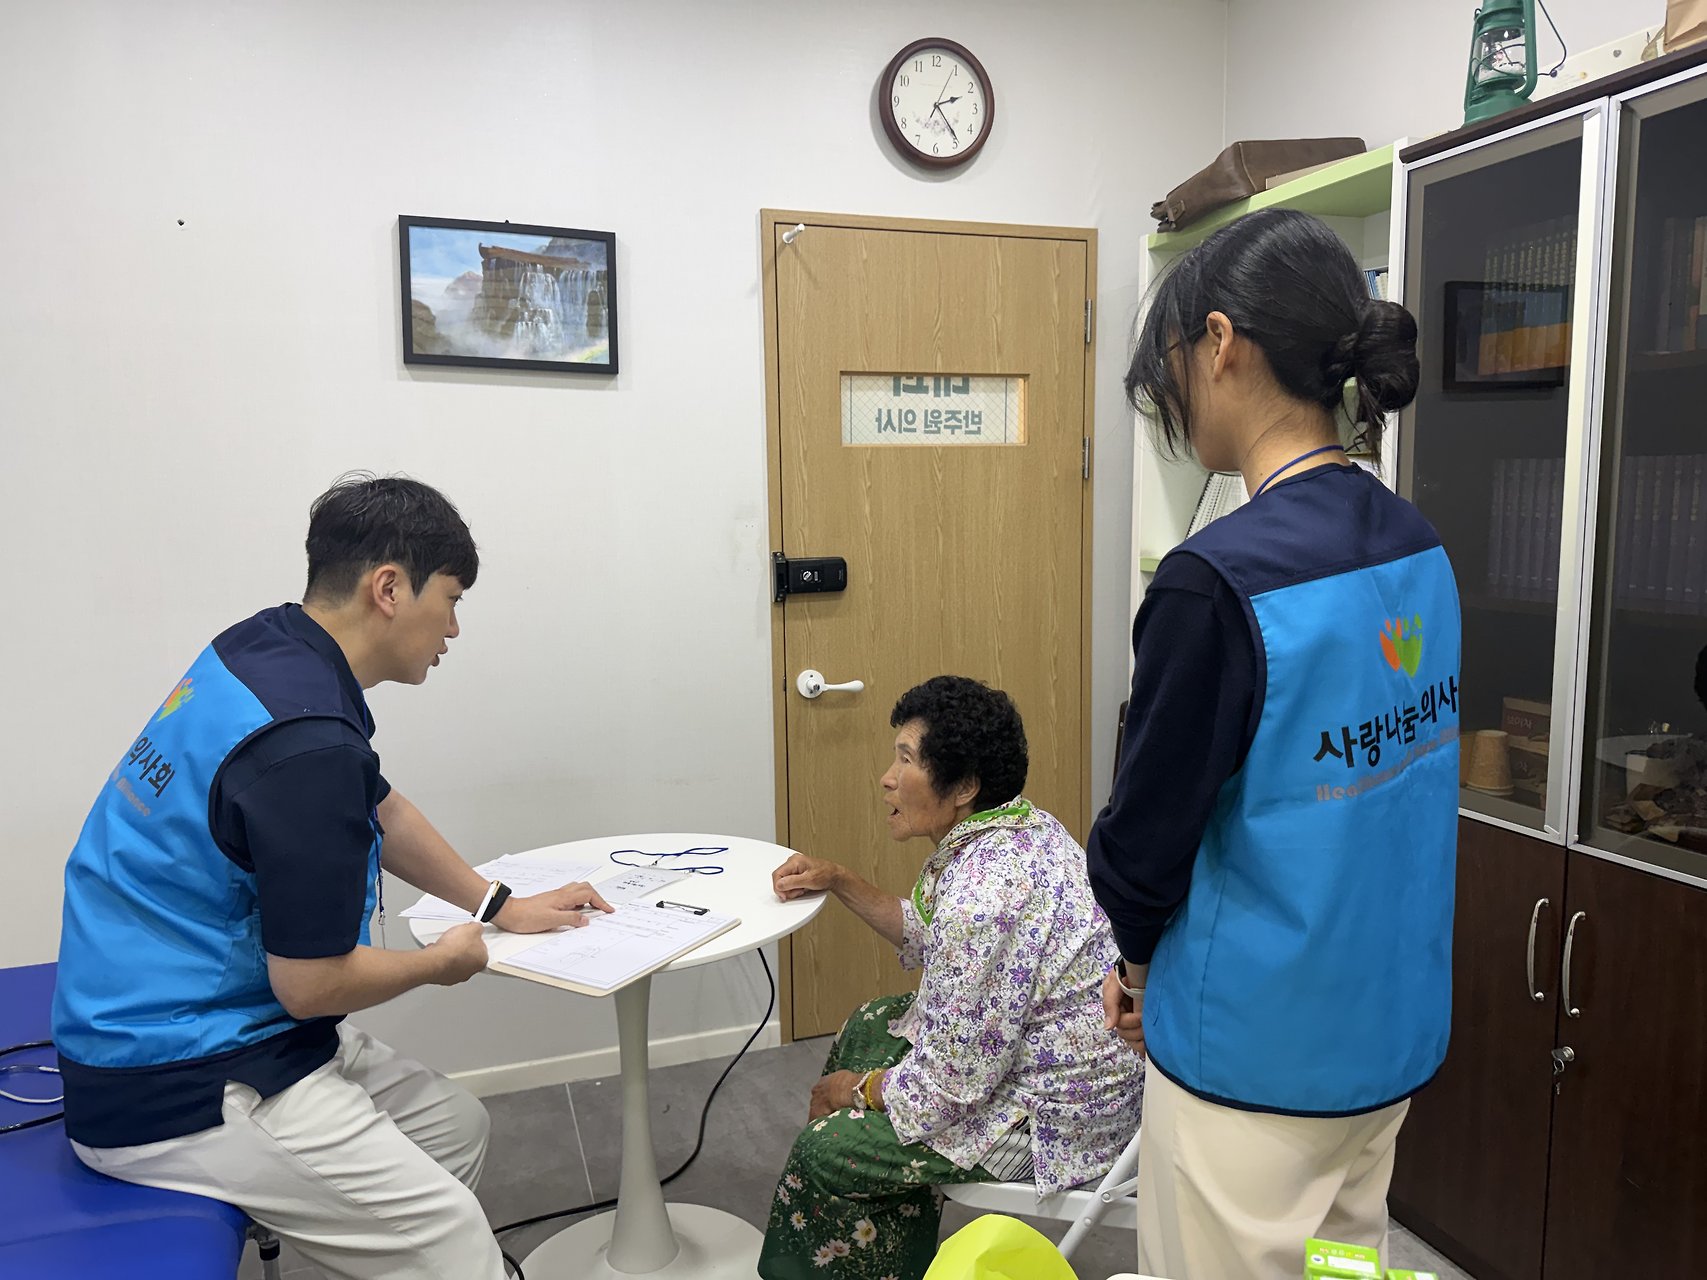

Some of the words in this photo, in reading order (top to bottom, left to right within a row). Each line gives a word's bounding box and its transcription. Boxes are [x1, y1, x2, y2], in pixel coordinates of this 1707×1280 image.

[914, 60, 923, 73] 11
[931, 55, 942, 68] 12
[953, 64, 958, 77] 1
[899, 75, 910, 87] 10
[967, 82, 975, 94] 2
[893, 96, 900, 107] 9
[972, 103, 978, 115] 3
[901, 117, 907, 129] 8
[967, 123, 973, 135] 4
[915, 134, 921, 146] 7
[952, 138, 958, 150] 5
[932, 142, 939, 154] 6
[1313, 675, 1458, 768] 사랑나눔의사
[128, 736, 176, 798] 의사회
